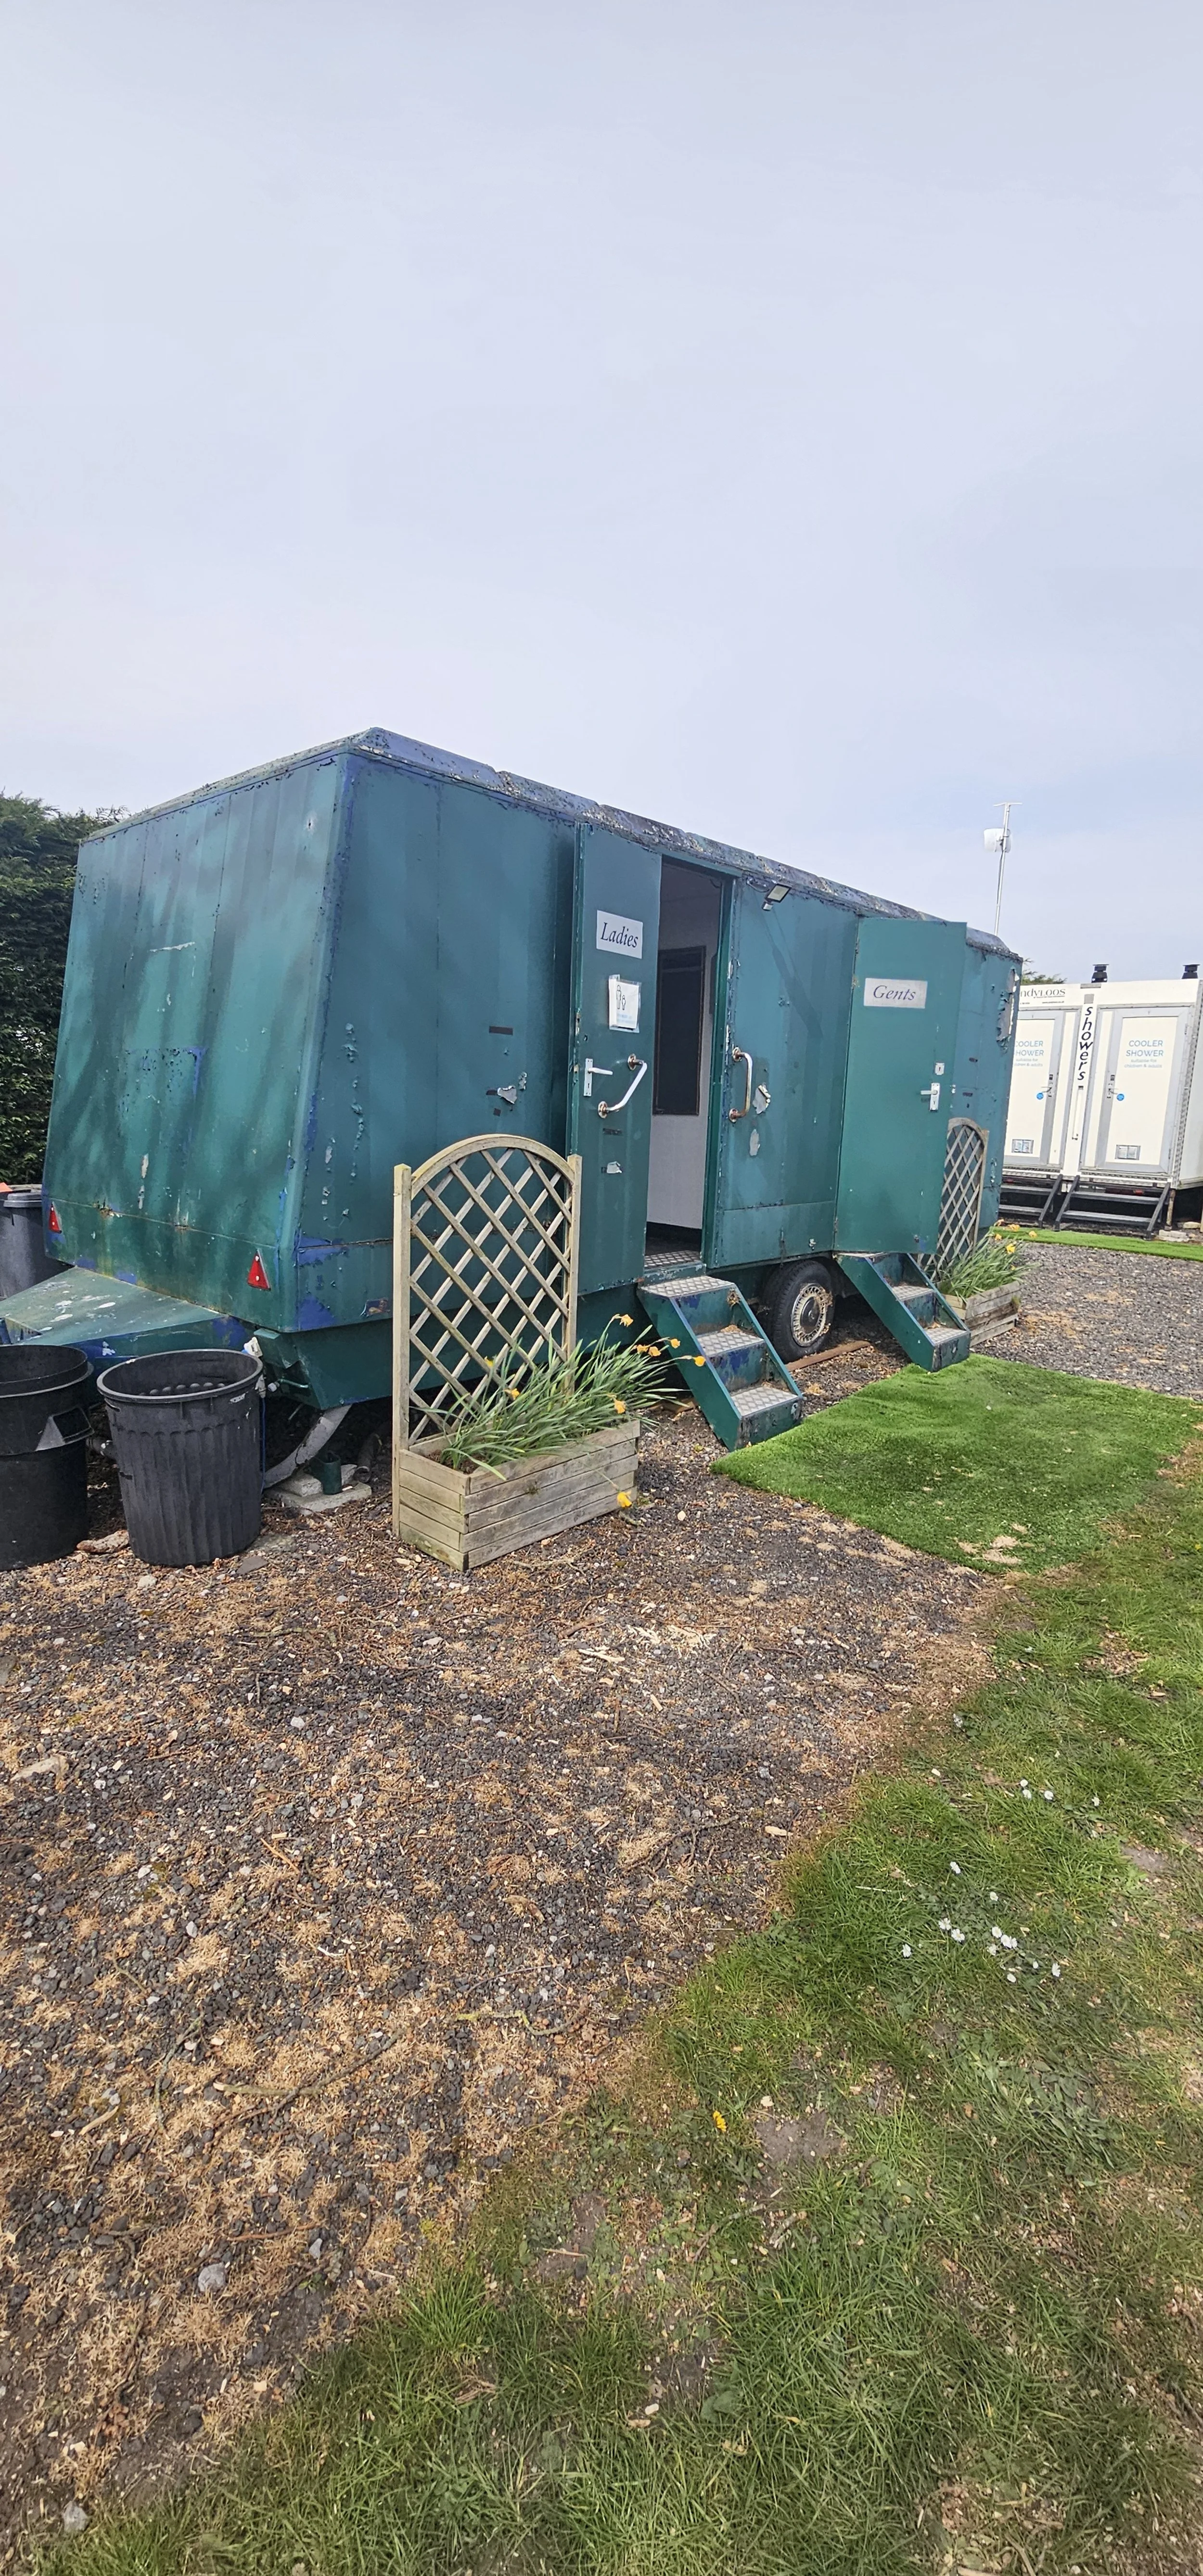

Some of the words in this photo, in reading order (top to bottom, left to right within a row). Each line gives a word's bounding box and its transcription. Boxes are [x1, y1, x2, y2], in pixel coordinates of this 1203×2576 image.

[600, 922, 639, 948] Ladies
[873, 985, 916, 1000] Gents
[1020, 988, 1065, 997] ndyLOOS
[1077, 1007, 1094, 1080] showers
